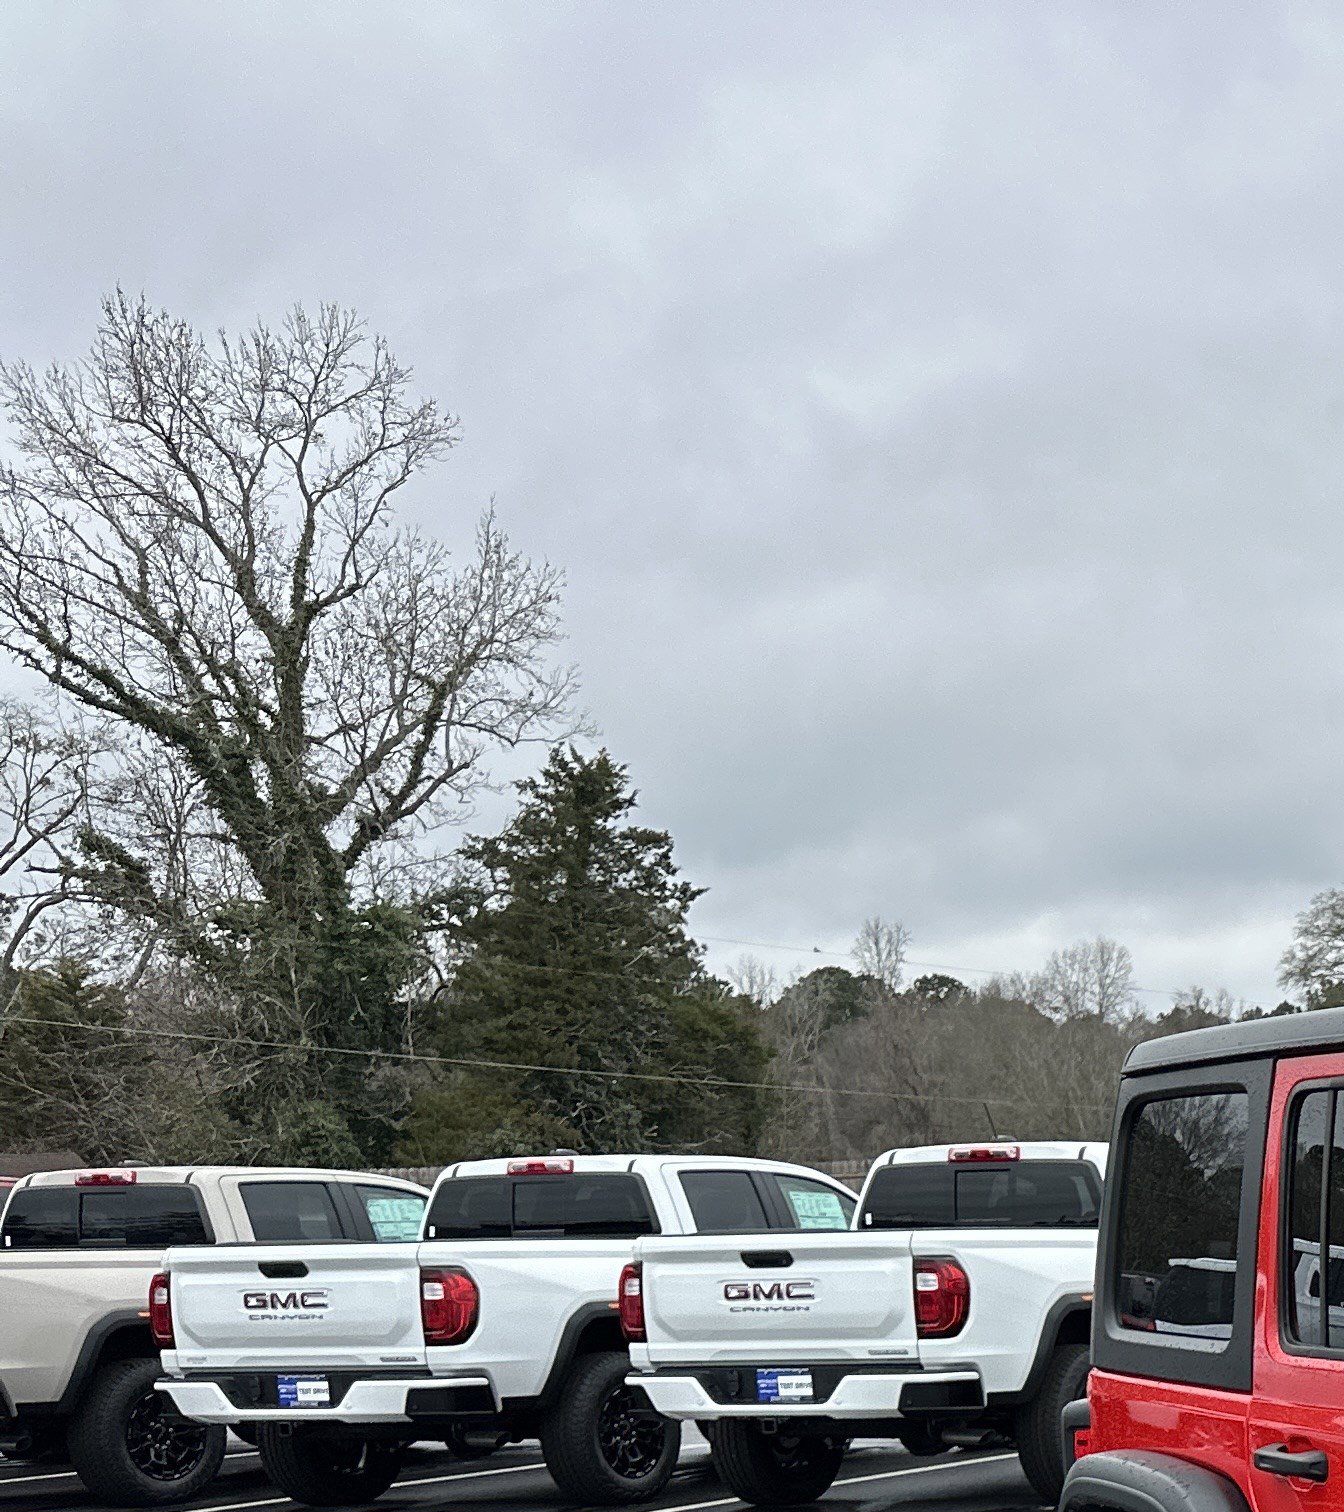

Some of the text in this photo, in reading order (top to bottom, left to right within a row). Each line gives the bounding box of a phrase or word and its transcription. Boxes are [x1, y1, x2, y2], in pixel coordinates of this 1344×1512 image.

[724, 1282, 815, 1301] GMC
[243, 1291, 329, 1310] GMC
[729, 1305, 811, 1313] CANYON
[248, 1313, 324, 1321] CANYON
